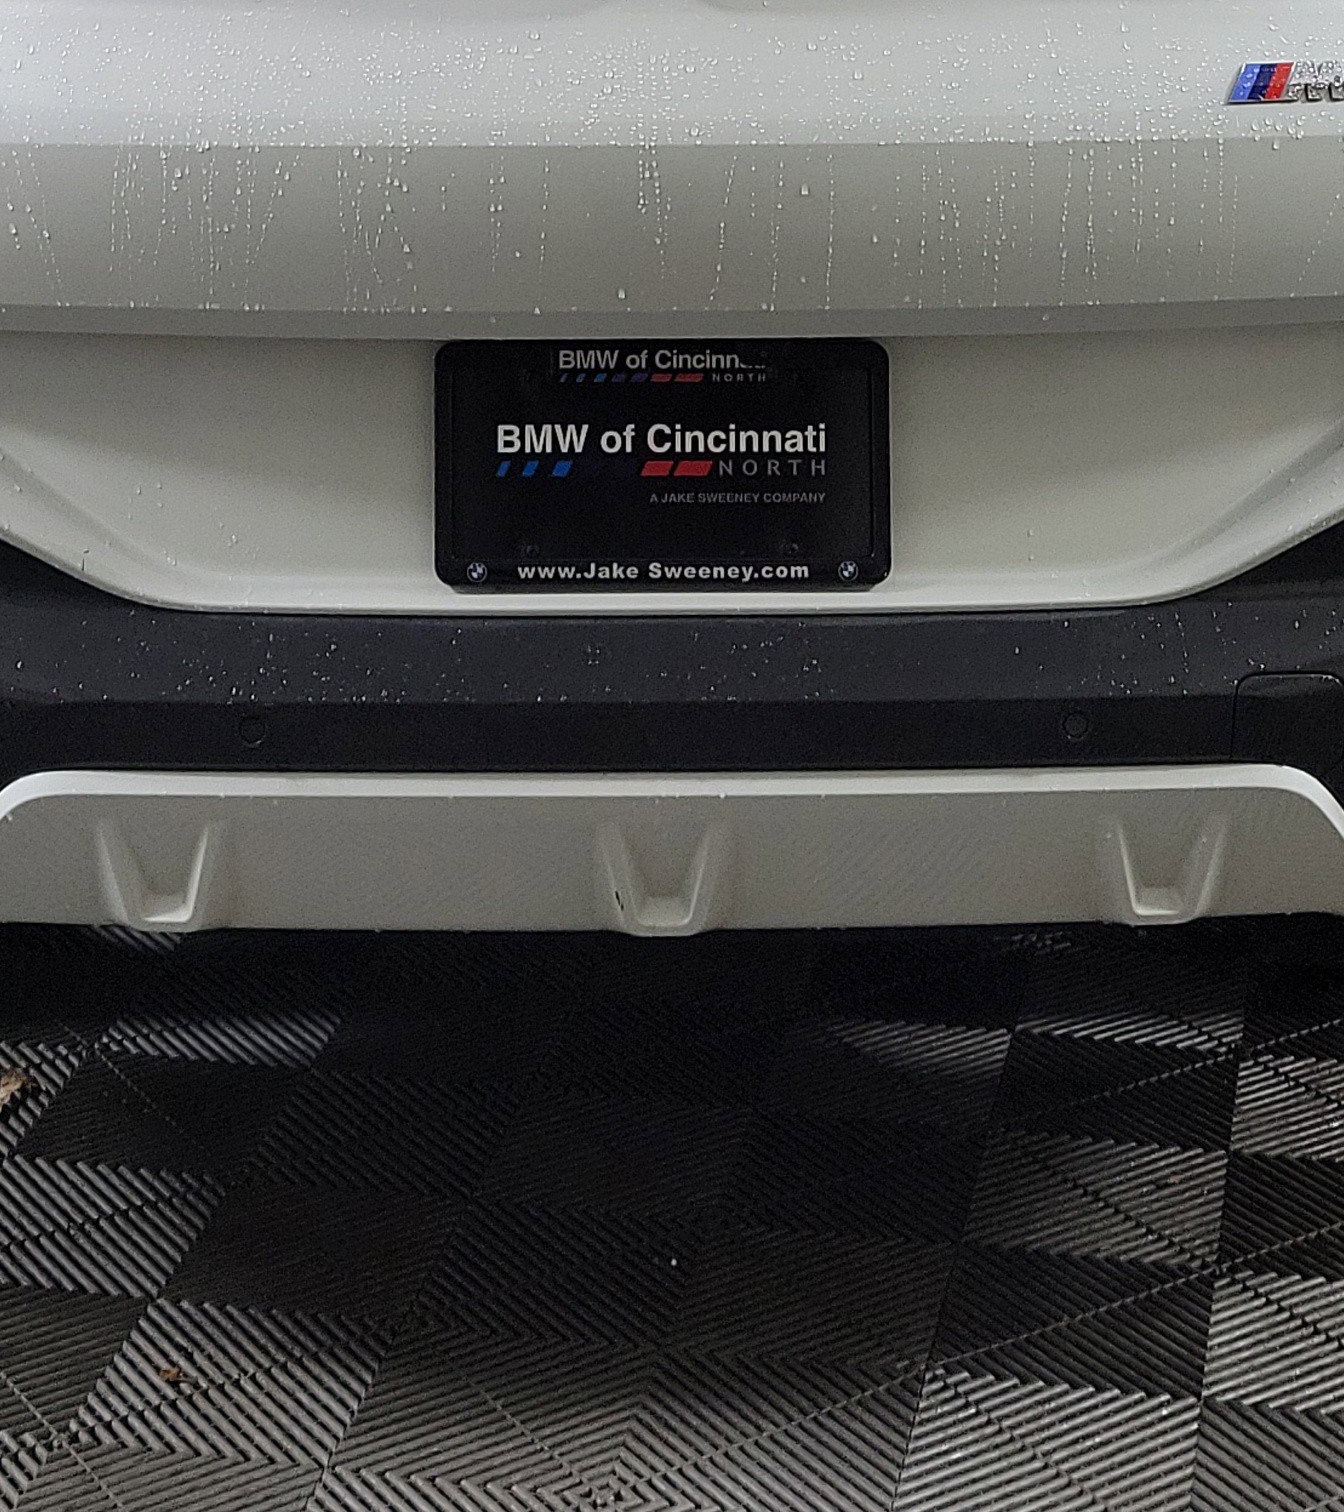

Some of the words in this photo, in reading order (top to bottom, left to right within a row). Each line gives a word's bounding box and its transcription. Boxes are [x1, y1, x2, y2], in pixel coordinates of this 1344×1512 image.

[558, 349, 619, 370] BMW
[625, 349, 649, 370] of
[655, 349, 767, 370] Cincinn
[712, 373, 767, 383] NORTH
[496, 423, 590, 454] BMW
[599, 423, 637, 454] of
[646, 423, 827, 454] Cincinnati
[718, 458, 827, 477] NORTH
[649, 492, 659, 504] A
[660, 492, 695, 504] JAKE
[698, 492, 760, 504] SWEENEY
[763, 492, 827, 504] COMPANY
[517, 562, 640, 580] www.Jake
[649, 561, 810, 583] Sweeney.com
